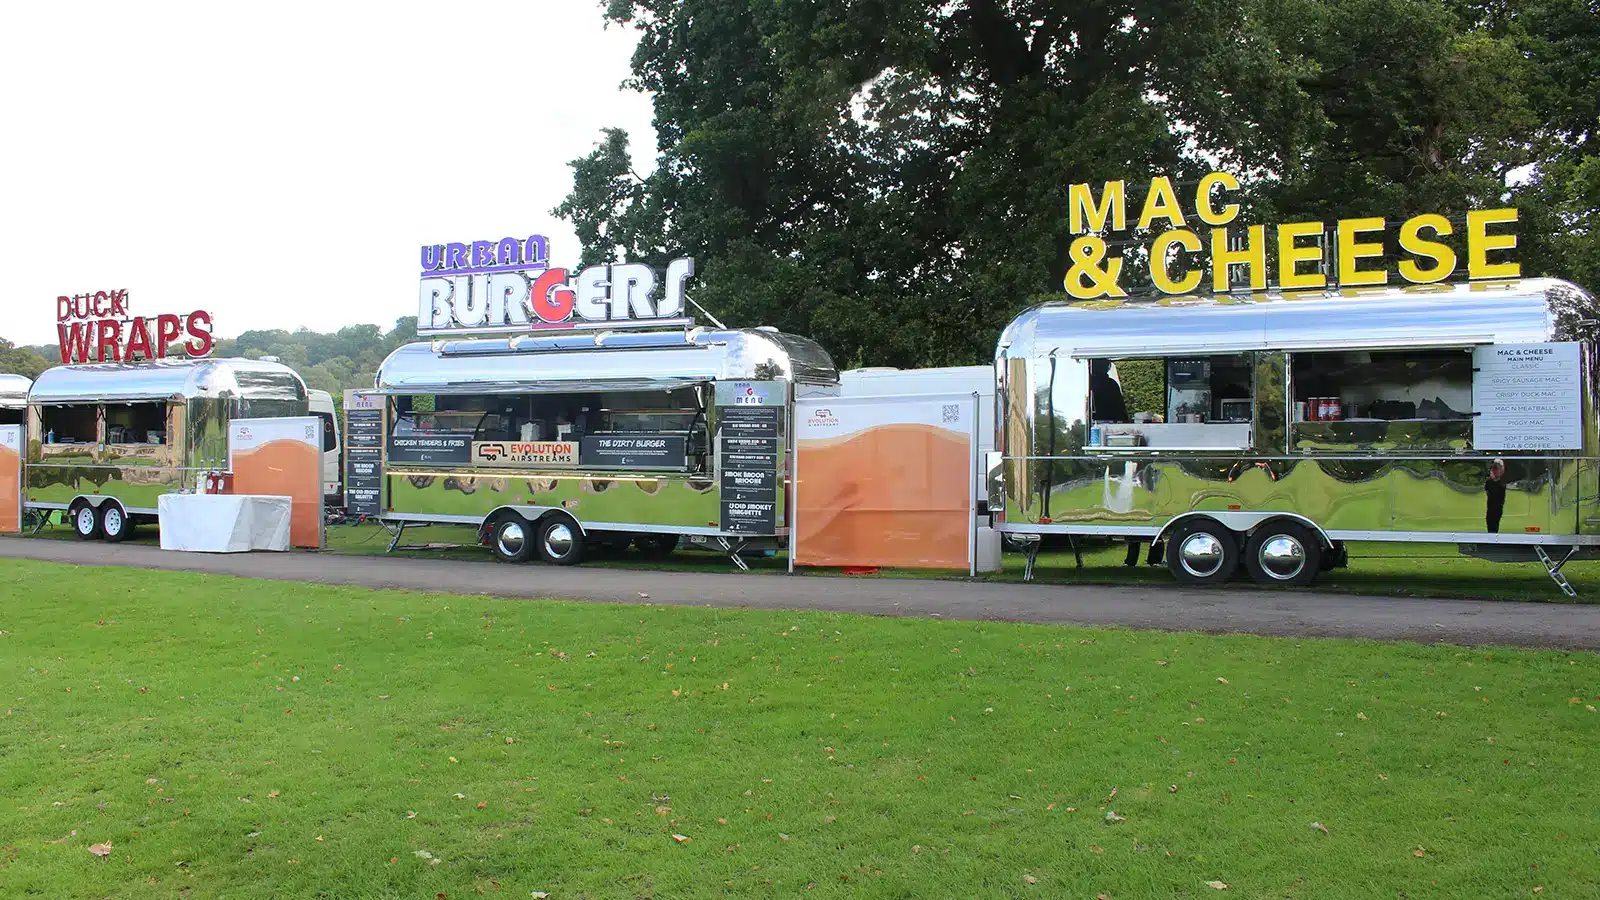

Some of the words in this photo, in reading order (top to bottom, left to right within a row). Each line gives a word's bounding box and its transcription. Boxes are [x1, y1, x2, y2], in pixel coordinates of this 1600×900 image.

[1069, 172, 1240, 234] MAC
[421, 234, 549, 270] URBAN
[1063, 236, 1128, 299] &
[1149, 208, 1521, 295] CHEESE
[57, 288, 128, 322] DUCK
[418, 257, 694, 329] BURGERS
[57, 309, 214, 364] WRAPS
[393, 439, 418, 447] CHICKEN
[418, 439, 443, 447] TENDERS
[447, 439, 465, 447] FRIES
[511, 443, 572, 455] EVOLUTION
[598, 439, 612, 447] THE
[612, 440, 636, 448] DIRTY
[636, 439, 667, 448] BURGER
